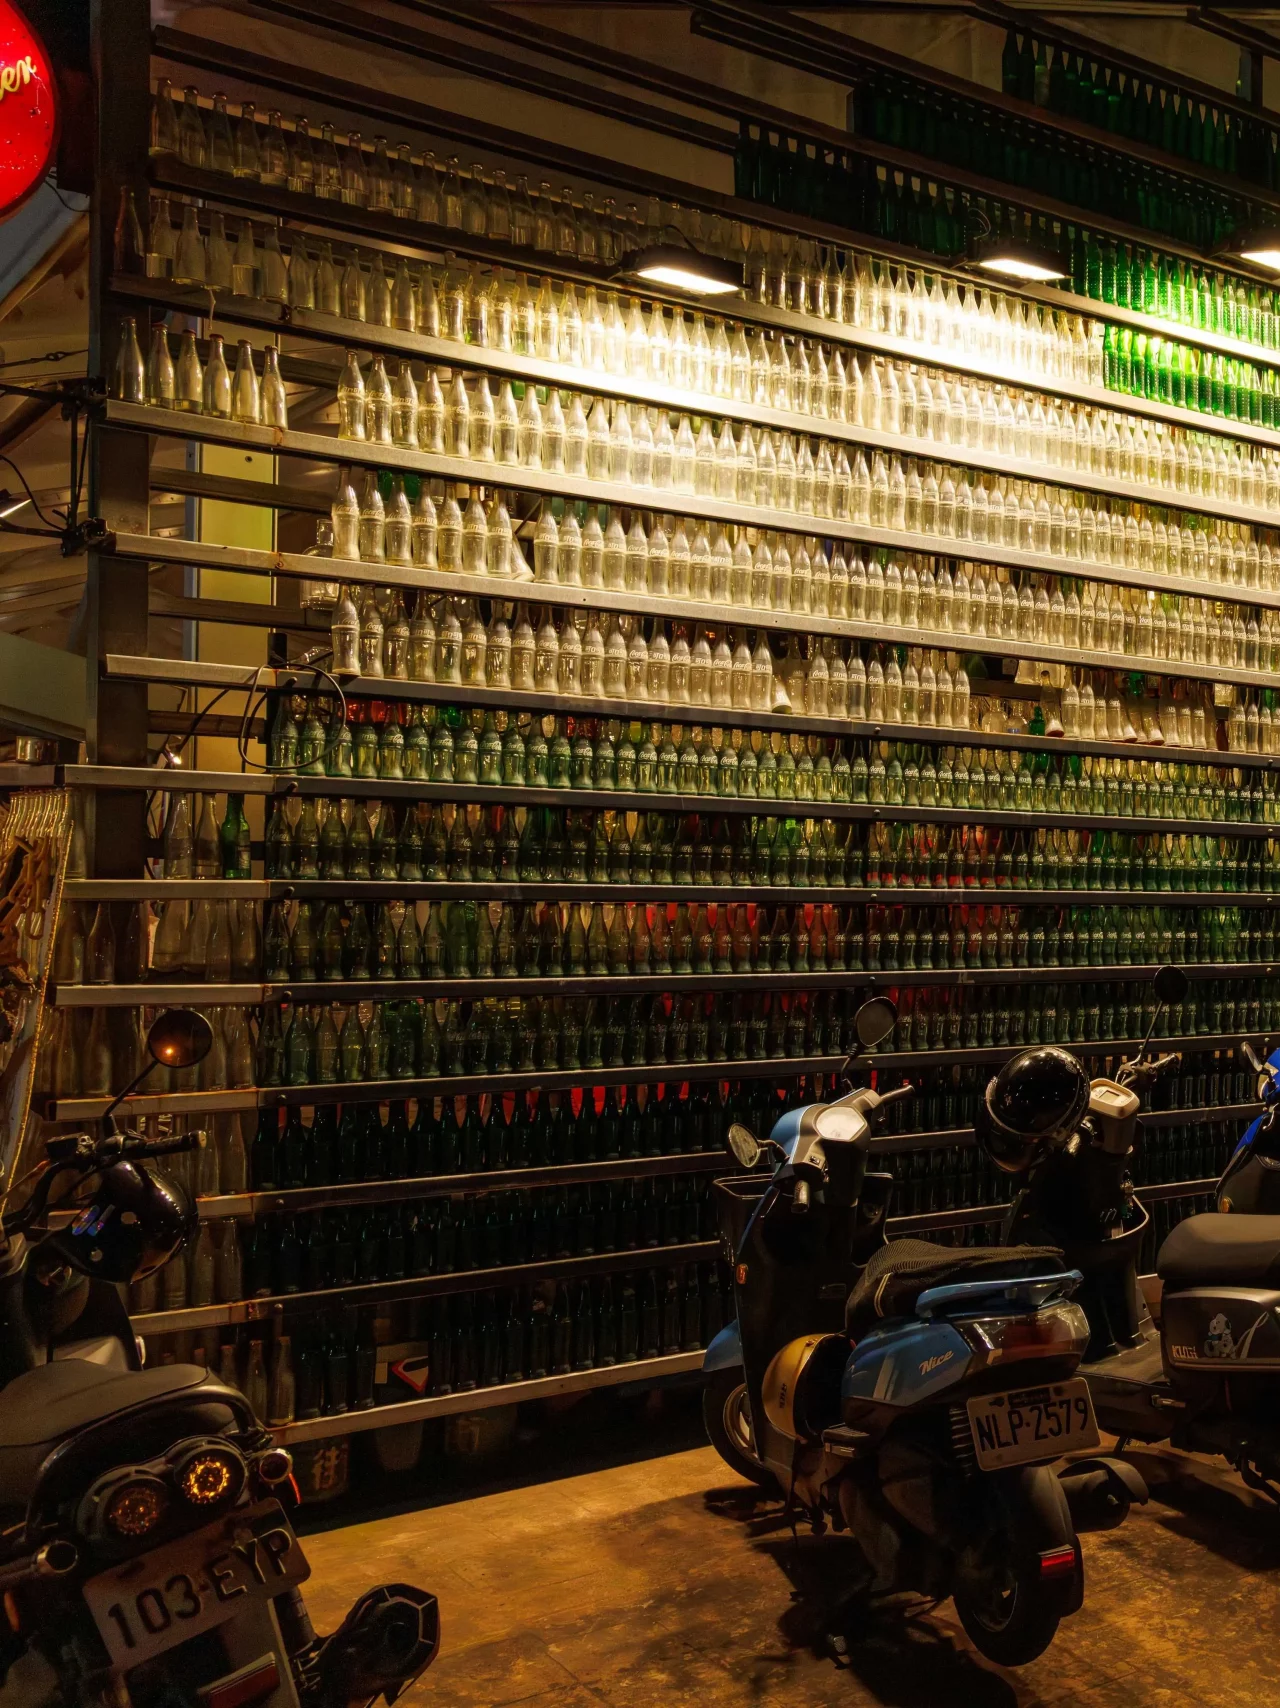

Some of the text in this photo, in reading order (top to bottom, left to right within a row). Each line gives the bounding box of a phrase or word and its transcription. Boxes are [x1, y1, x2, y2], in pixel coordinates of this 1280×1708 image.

[918, 1350, 954, 1376] Nice
[975, 1396, 1089, 1452] NLP-2579
[107, 1527, 293, 1649] 103-EYP
